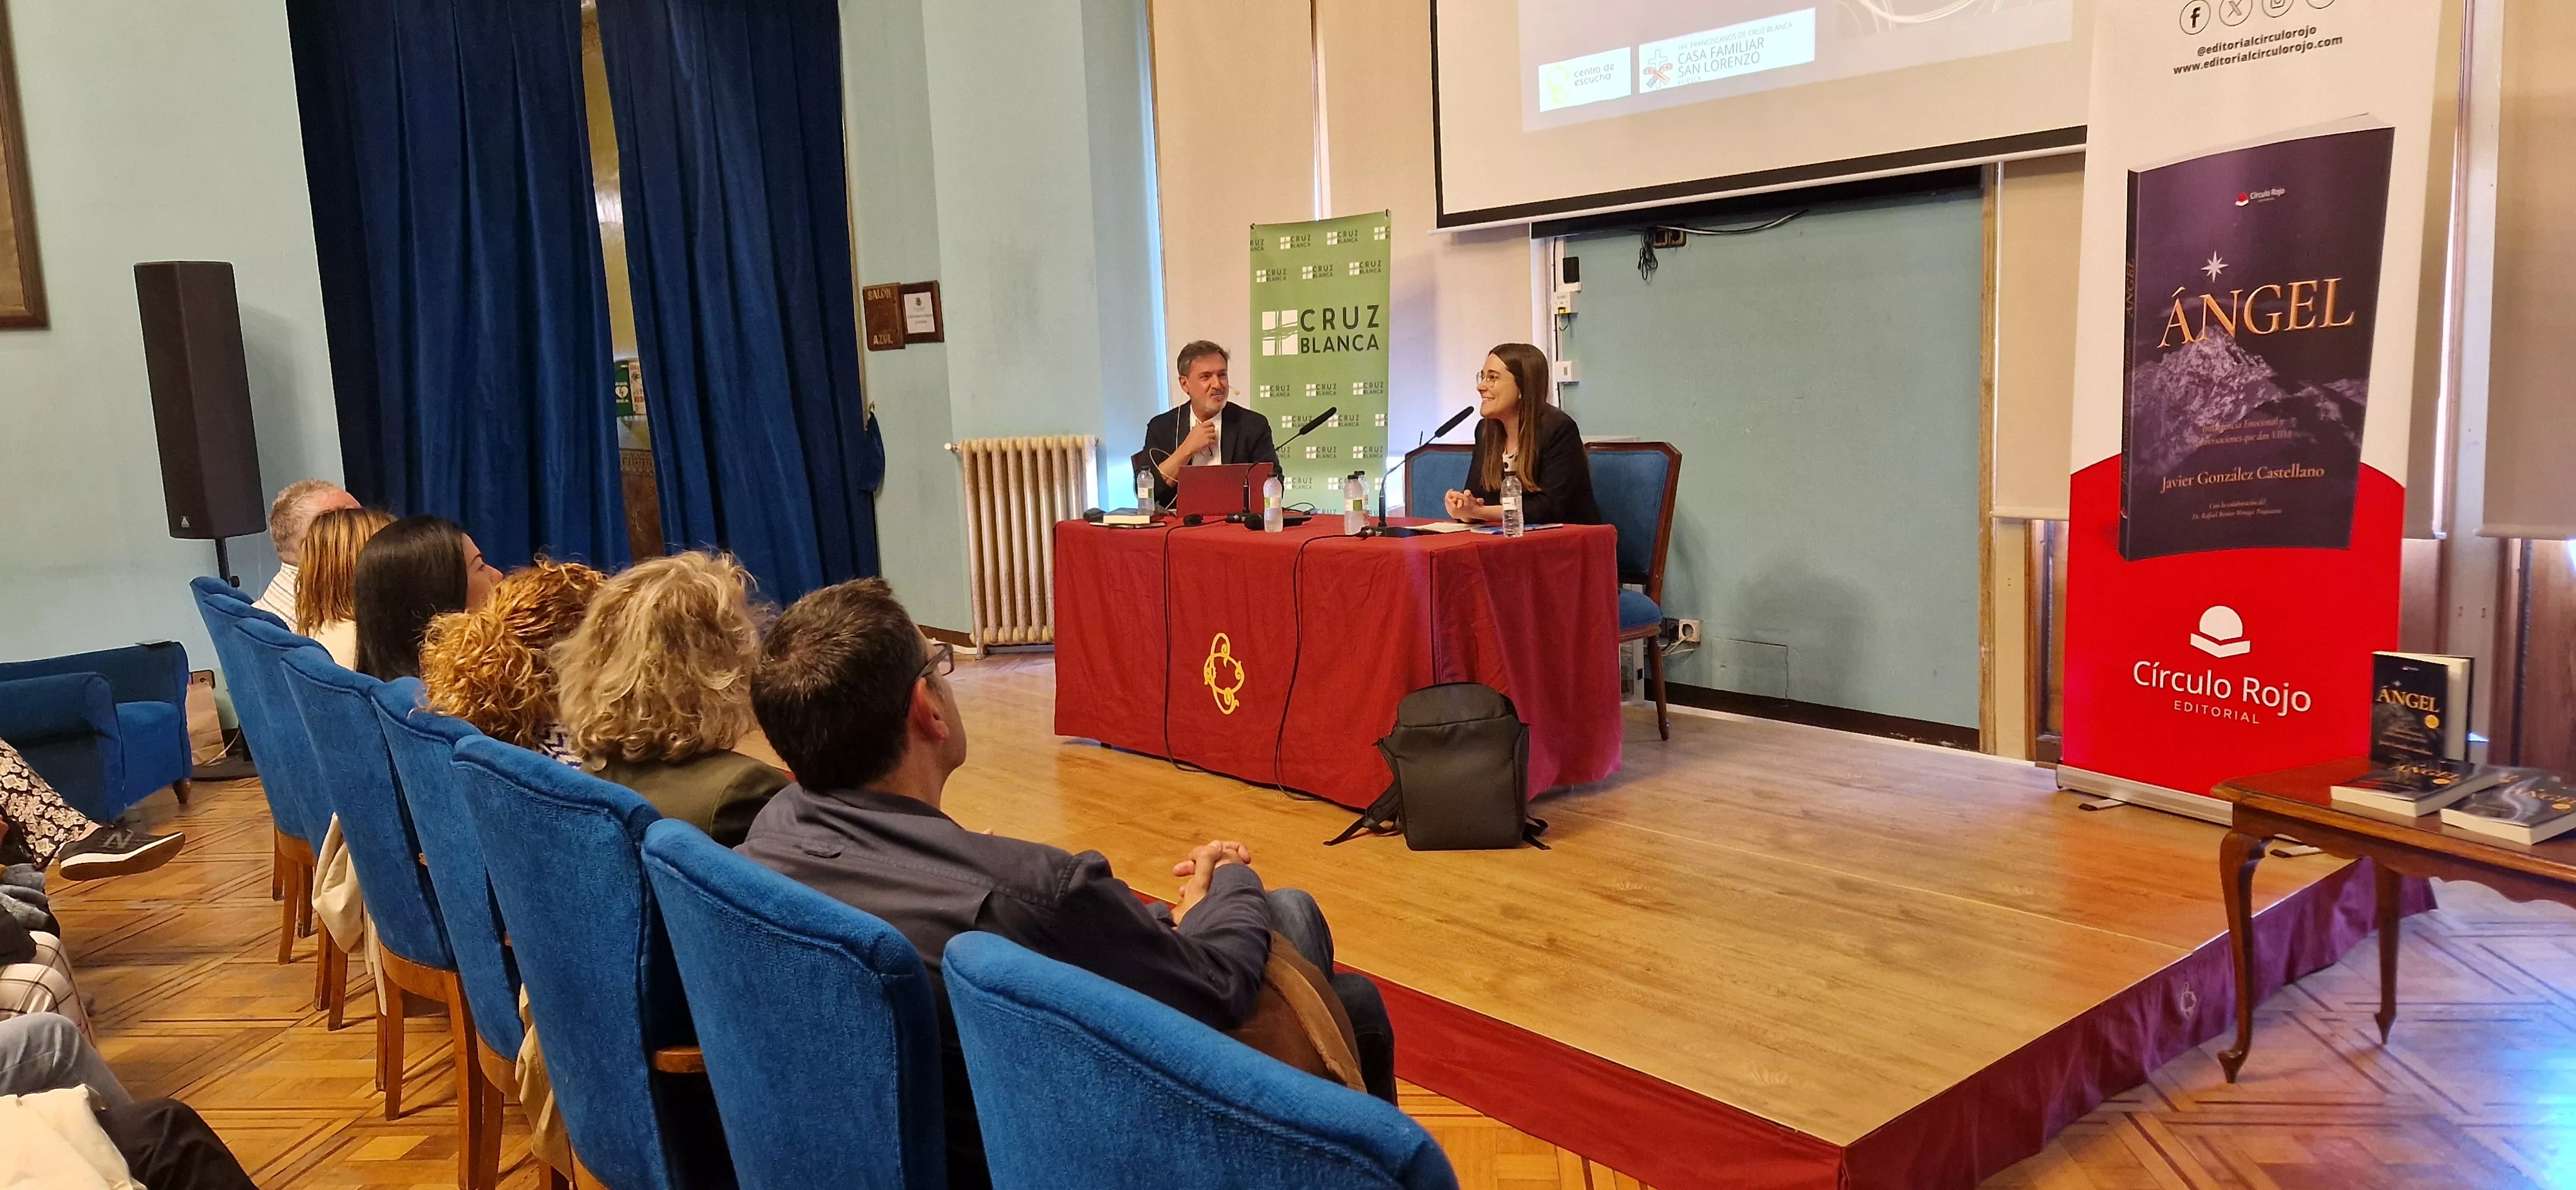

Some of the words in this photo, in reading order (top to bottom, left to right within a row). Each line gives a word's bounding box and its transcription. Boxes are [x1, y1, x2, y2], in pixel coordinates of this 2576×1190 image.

[1690, 33, 1736, 48] FRANCISCANOS
[1748, 27, 1765, 37] CRUZ
[1767, 21, 1793, 33] BLANCA
[2197, 25, 2317, 57] @editorialcirculorojo
[1678, 49, 1707, 64] CASA
[1710, 37, 1765, 59] FAMILIAR
[2173, 35, 2343, 75] www.editorialcirculorojo.com
[1574, 66, 1601, 77] centro
[1604, 63, 1615, 71] de
[1678, 63, 1700, 78] SAN
[1704, 52, 1760, 73] LORENZO
[1574, 73, 1611, 86] escucha
[1291, 234, 1311, 243] CRUZ
[1300, 305, 1379, 332] CRUZ
[2157, 278, 2355, 348] ÁNGEL
[873, 334, 893, 345] AZUL
[1300, 334, 1379, 354] BLANCA
[2160, 475, 2194, 494] Javier
[2197, 467, 2253, 485] González
[2257, 463, 2325, 480] Castellano
[2133, 661, 2231, 699] Círculo
[2242, 677, 2311, 717] Rojo
[2376, 685, 2441, 713] ÁNGEL
[2174, 700, 2260, 724] EDITORIAL
